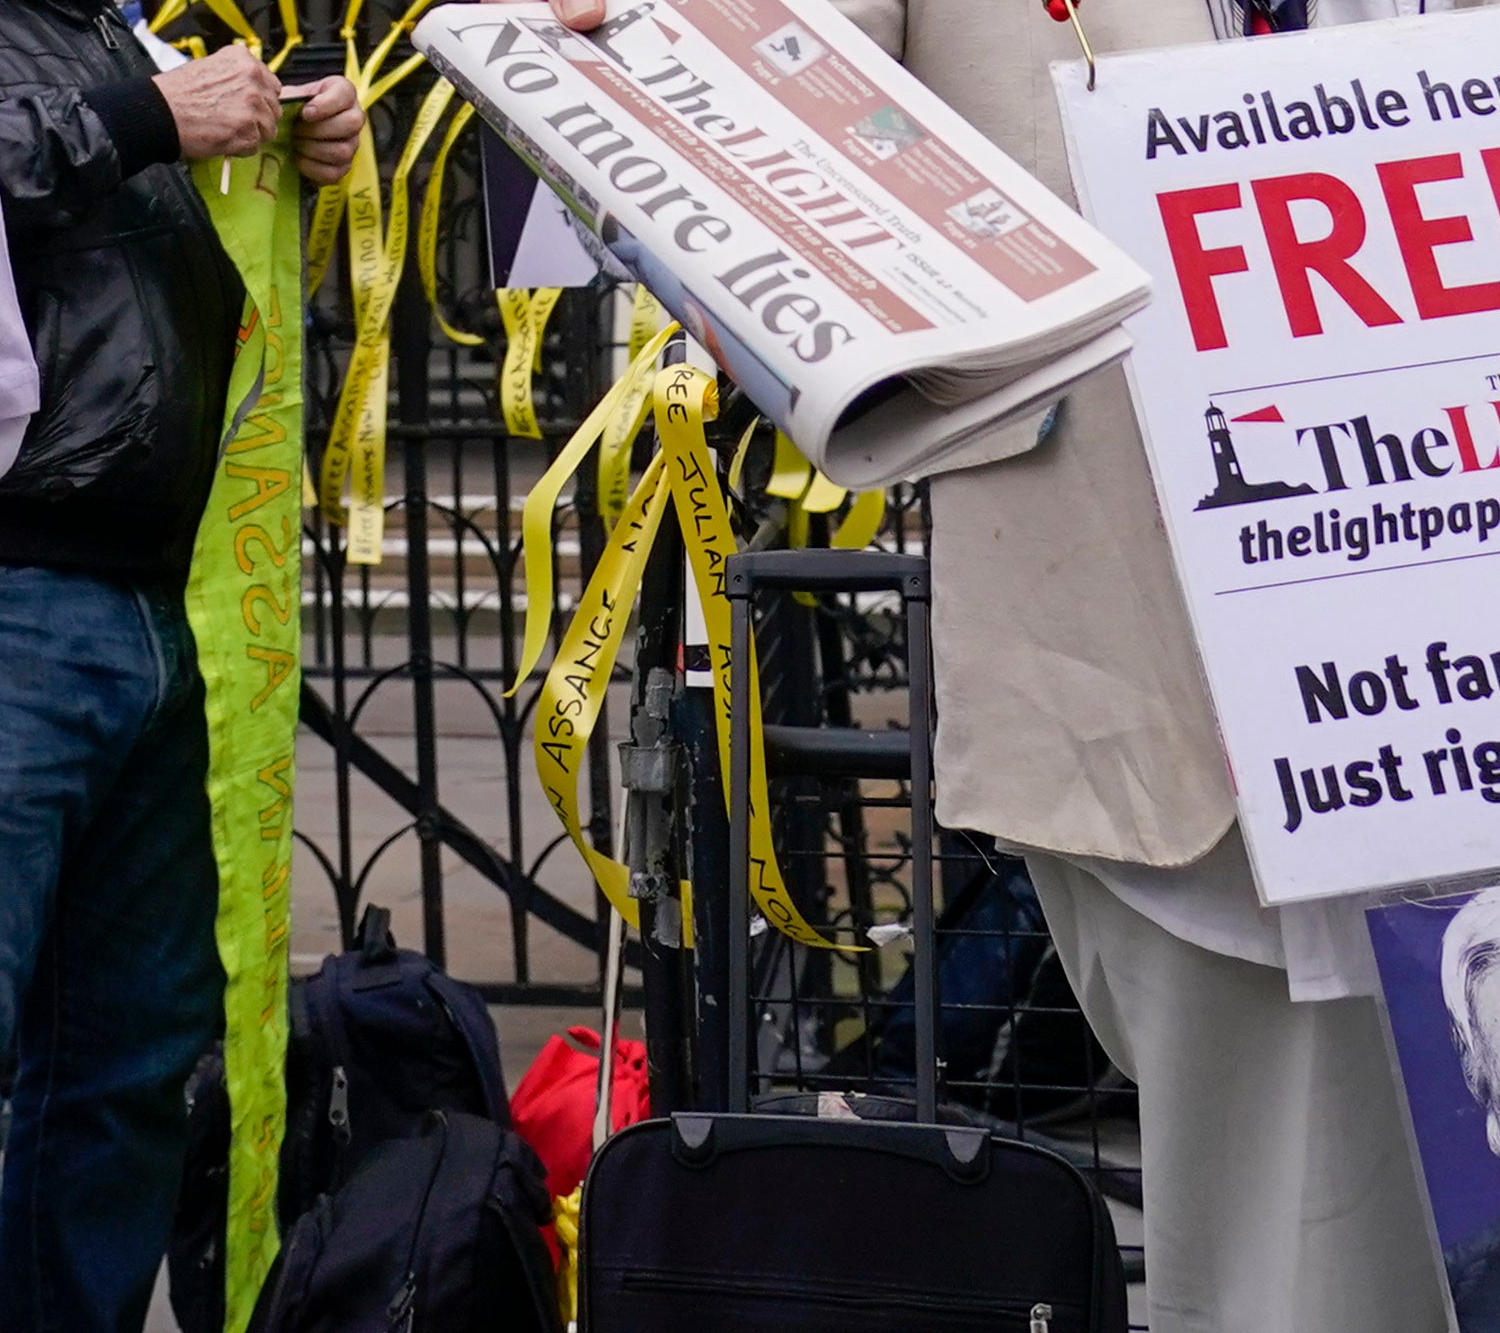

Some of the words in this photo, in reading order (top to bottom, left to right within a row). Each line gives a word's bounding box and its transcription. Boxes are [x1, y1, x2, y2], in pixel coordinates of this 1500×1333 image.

[1144, 89, 1412, 161] Available
[446, 16, 559, 95] No
[542, 102, 732, 254] more
[713, 247, 856, 364] lies
[674, 450, 727, 600] JULIAN
[1294, 653, 1420, 725] Not
[1273, 750, 1413, 835] Just
